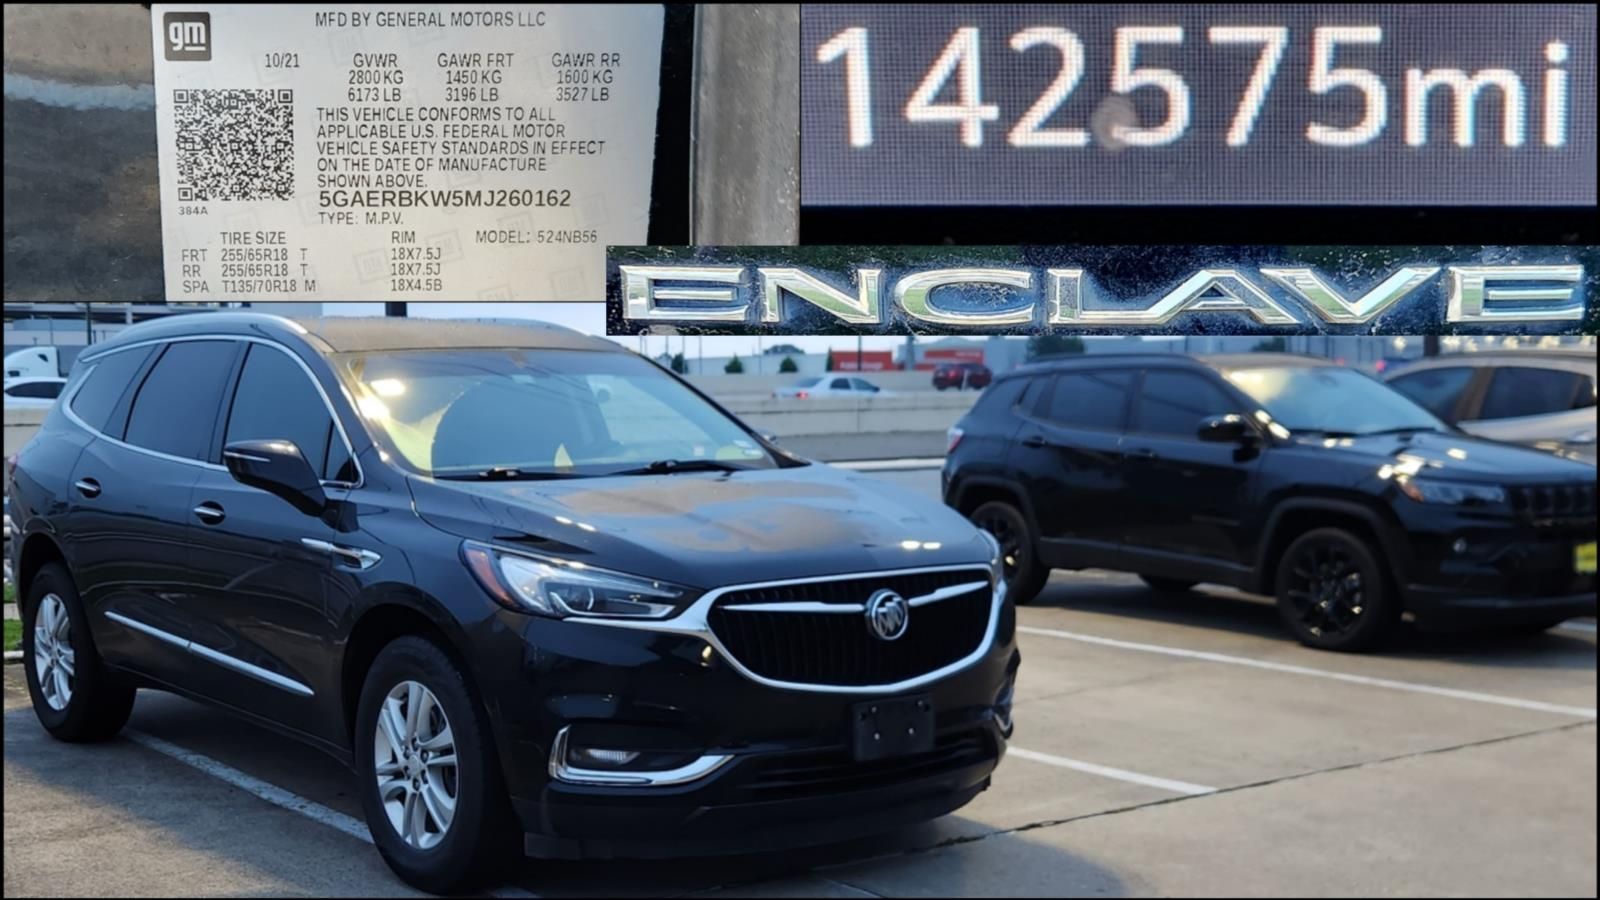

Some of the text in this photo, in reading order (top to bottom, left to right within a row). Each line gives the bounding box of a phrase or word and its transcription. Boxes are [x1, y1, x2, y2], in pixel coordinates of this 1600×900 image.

[315, 11, 546, 27] MFD BY GENERAL MOTORS LLC
[168, 22, 206, 51] gm
[265, 53, 300, 68] 10/21
[353, 53, 398, 68] GVWR
[437, 53, 514, 67] GAWR FRT
[552, 53, 621, 67] GAWR RR
[348, 70, 404, 85] 2800 KG
[446, 70, 502, 84] 1450 KG
[557, 70, 613, 84] 1600 KG
[348, 87, 401, 102] 6173 LB
[445, 87, 499, 101] 3196 LB
[556, 87, 609, 101] 3527 LB
[316, 107, 556, 121] THIS VEHICLE CONFORMS TO ALL
[316, 124, 565, 139] APPLICABLE U.S. FEDERAL MOTOR
[316, 141, 605, 155] VEHICLE SAFETY STANDARDS IN EFFECT
[317, 157, 547, 171] ON THE DATE OF MANUFACTURE
[317, 174, 428, 188] SHOWN ABOVE.
[319, 190, 571, 207] 5GAERBKW5MJ260162
[178, 206, 208, 215] 384A
[319, 212, 404, 225] TYPE: M.P.V.
[220, 231, 287, 245] TIRE SIZE
[391, 231, 416, 244] RIM
[475, 230, 598, 244] MODEL: 524NB56
[182, 248, 308, 262] FRT 255/65R18 T
[391, 247, 441, 260] 18X7.5J
[182, 264, 308, 277] RR 255/65R18 T
[391, 263, 441, 276] 18X7.5J
[182, 280, 317, 293] SPA T135/70R18 M
[391, 279, 442, 292] 18X4.5B
[619, 264, 1587, 325] ENCLAVE
